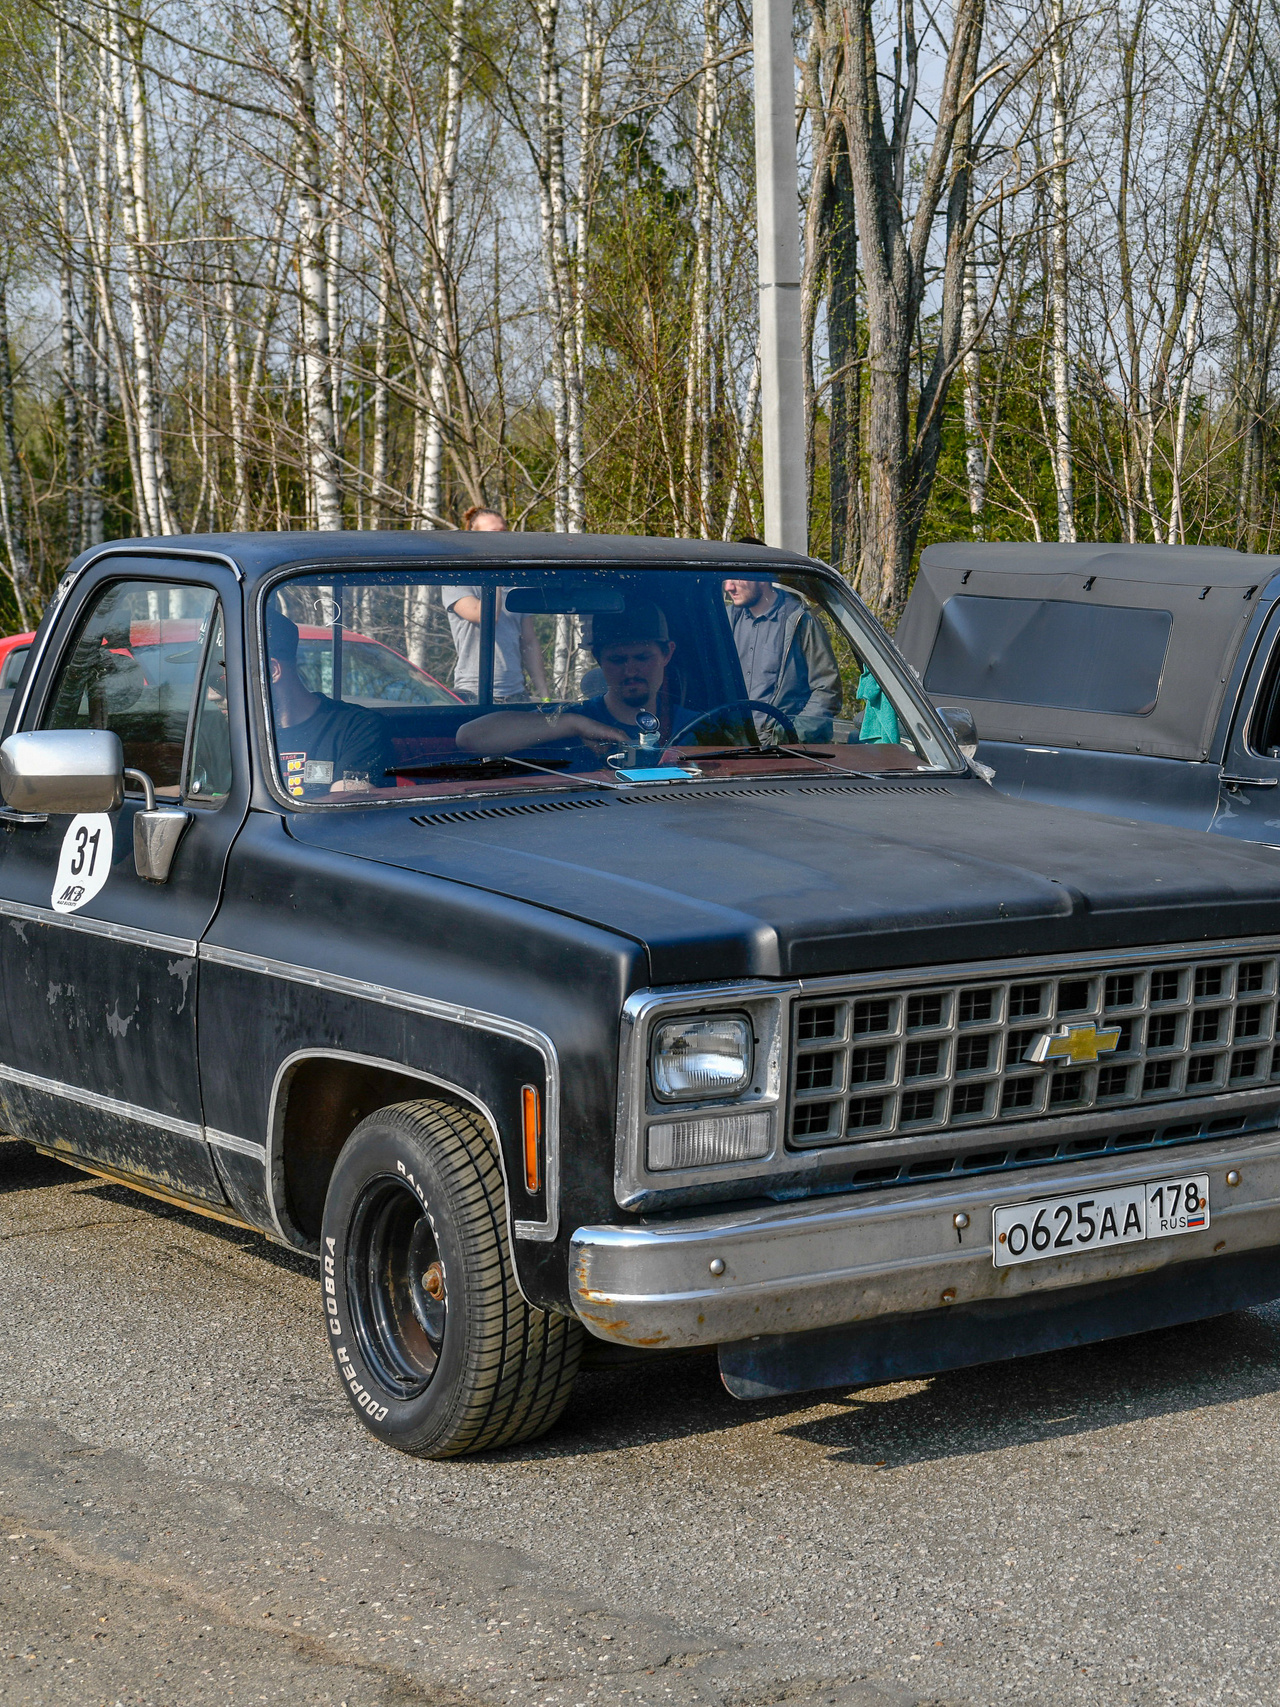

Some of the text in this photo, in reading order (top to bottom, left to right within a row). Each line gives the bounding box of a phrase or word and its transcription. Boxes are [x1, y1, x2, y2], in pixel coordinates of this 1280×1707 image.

[71, 826, 101, 876] 31
[1150, 1182, 1200, 1218] 178
[1160, 1217, 1187, 1231] RUS
[324, 1236, 389, 1422] COOPER COBRA
